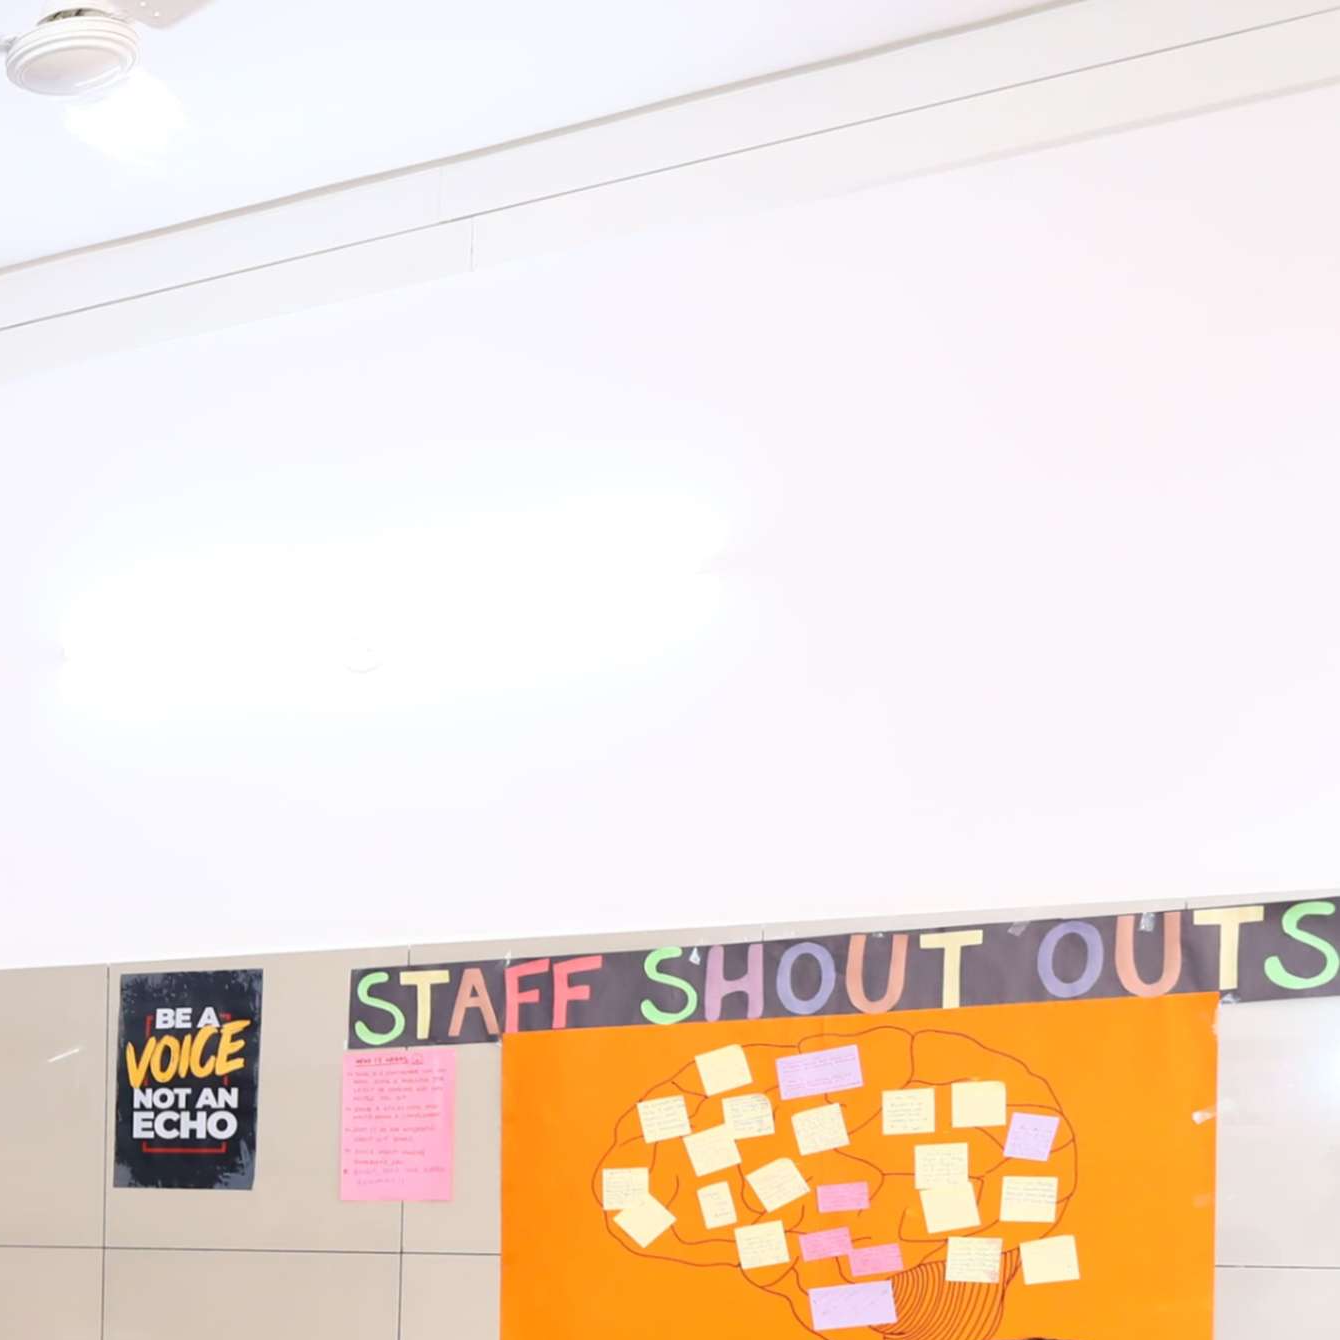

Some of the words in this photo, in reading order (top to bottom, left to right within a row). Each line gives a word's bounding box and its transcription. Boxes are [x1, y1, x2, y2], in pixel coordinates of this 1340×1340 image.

[354, 955, 604, 1046] STAFF
[641, 929, 984, 1026] SHOUT
[1037, 900, 1340, 998] OUTS
[155, 1007, 193, 1030] BE
[197, 1006, 221, 1028] A
[126, 1019, 251, 1089] VOICE
[133, 1087, 192, 1110] NOT
[196, 1087, 239, 1109] AN
[132, 1110, 238, 1140] ECHO
